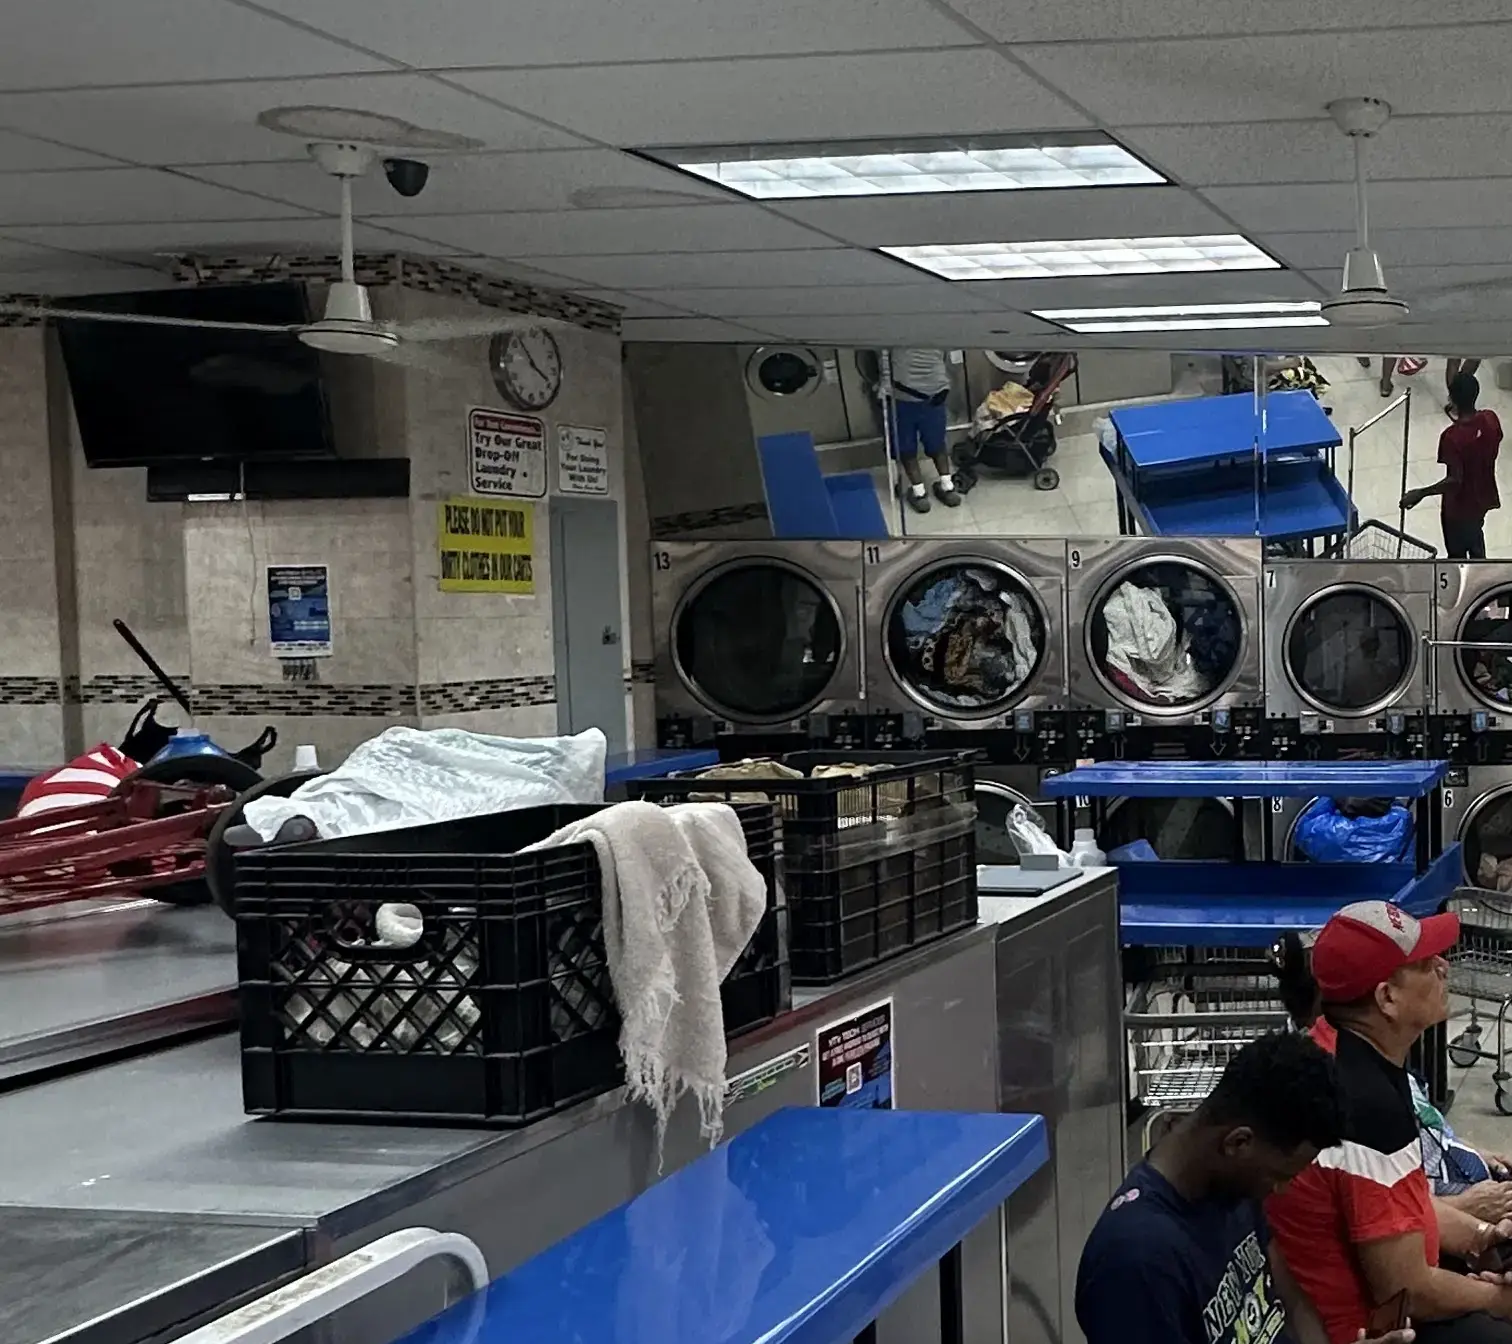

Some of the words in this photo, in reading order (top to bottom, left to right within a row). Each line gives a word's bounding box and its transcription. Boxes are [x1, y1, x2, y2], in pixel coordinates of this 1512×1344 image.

[475, 432, 491, 447] Try
[495, 435, 511, 446] Our
[515, 437, 541, 451] Great
[475, 447, 520, 462] Drop-Off
[476, 462, 516, 478] Laundry
[475, 476, 512, 491] Service
[445, 505, 470, 534] PLEASE
[471, 507, 480, 536] DO
[481, 508, 494, 537] NOT
[495, 509, 508, 537] PUT
[509, 510, 525, 538] YOUR
[655, 552, 670, 570] 13
[867, 546, 880, 564] 11
[1072, 551, 1080, 567] 9
[441, 550, 461, 579] DIRTY
[462, 551, 490, 580] CLOTHES
[491, 553, 499, 581] IN
[500, 553, 512, 581] OUR
[513, 554, 532, 581] CARTS
[1266, 570, 1275, 587] 7
[1440, 572, 1447, 589] 5
[1273, 796, 1281, 811] 8
[1445, 790, 1452, 806] 6
